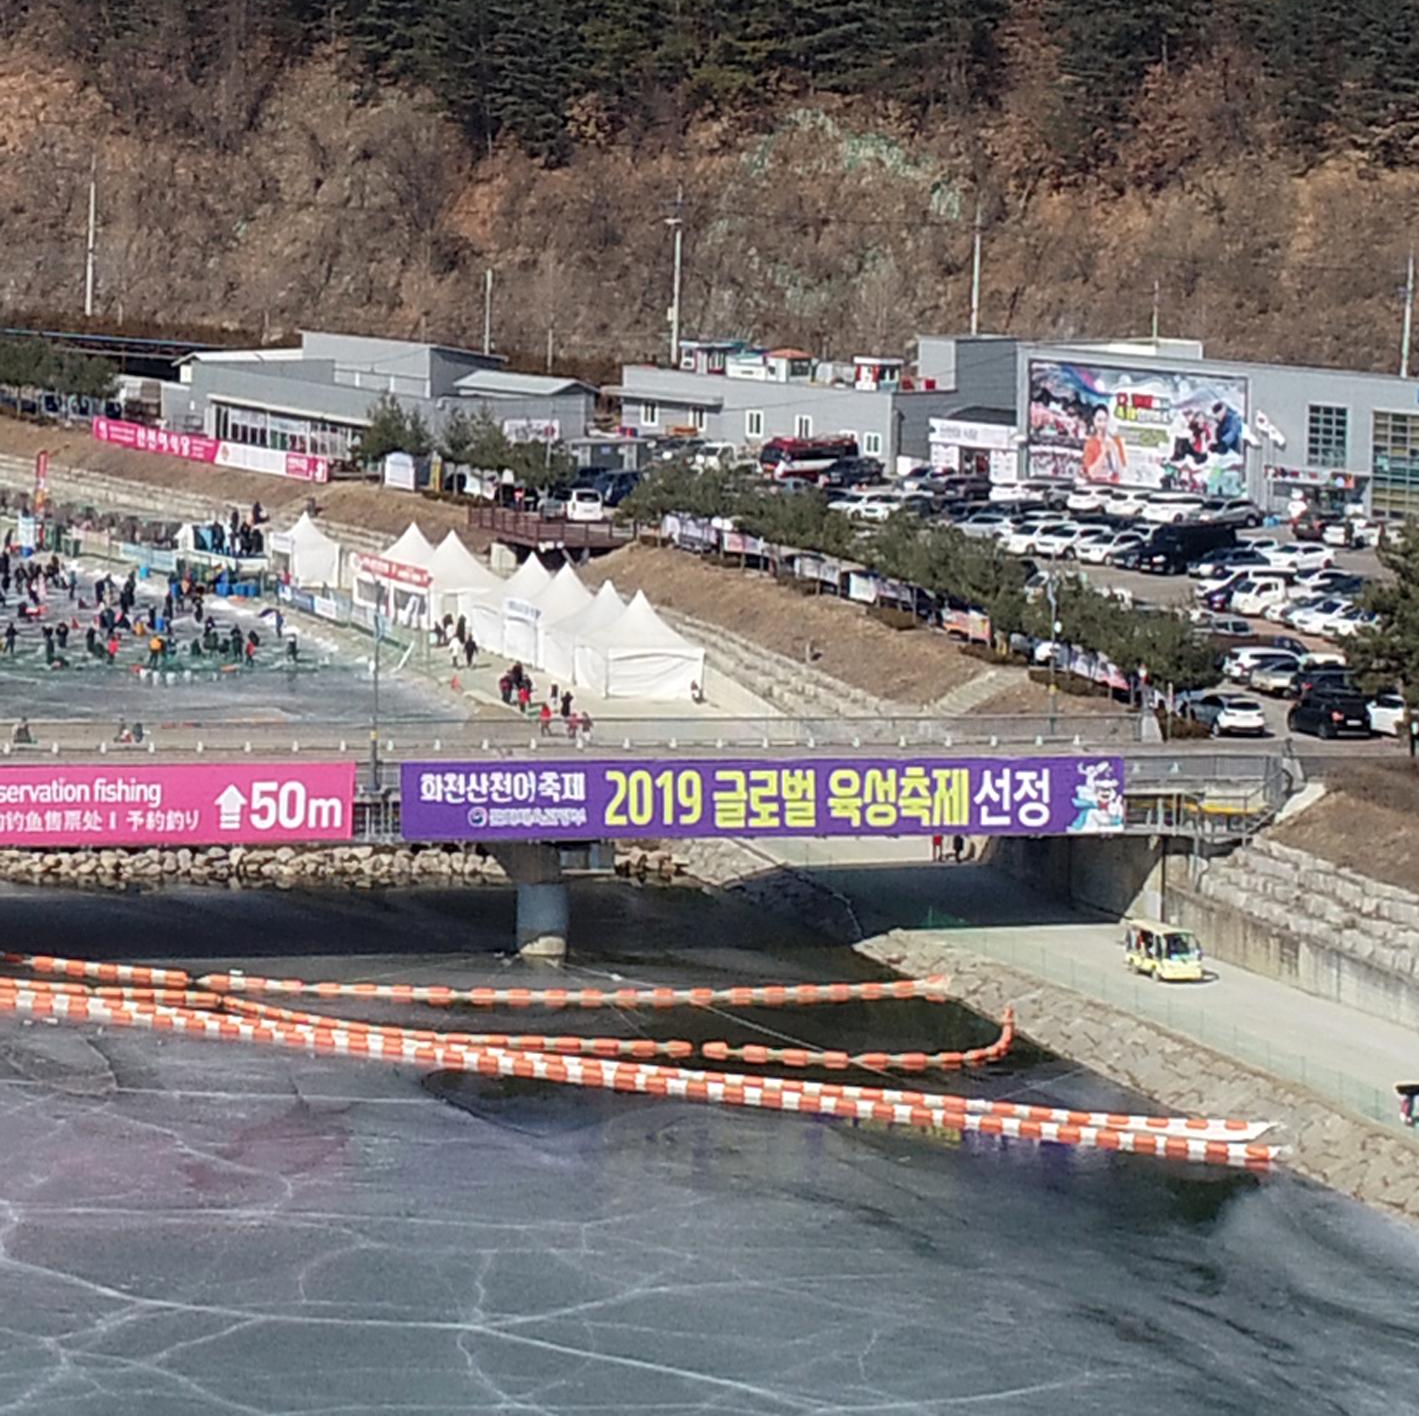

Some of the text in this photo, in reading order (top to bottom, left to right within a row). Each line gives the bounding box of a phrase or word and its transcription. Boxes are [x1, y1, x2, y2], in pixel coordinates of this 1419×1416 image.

[93, 778, 162, 808] fishing
[249, 780, 343, 830] 50m
[604, 766, 1051, 828] 2019 글로벌 육성축제 선정
